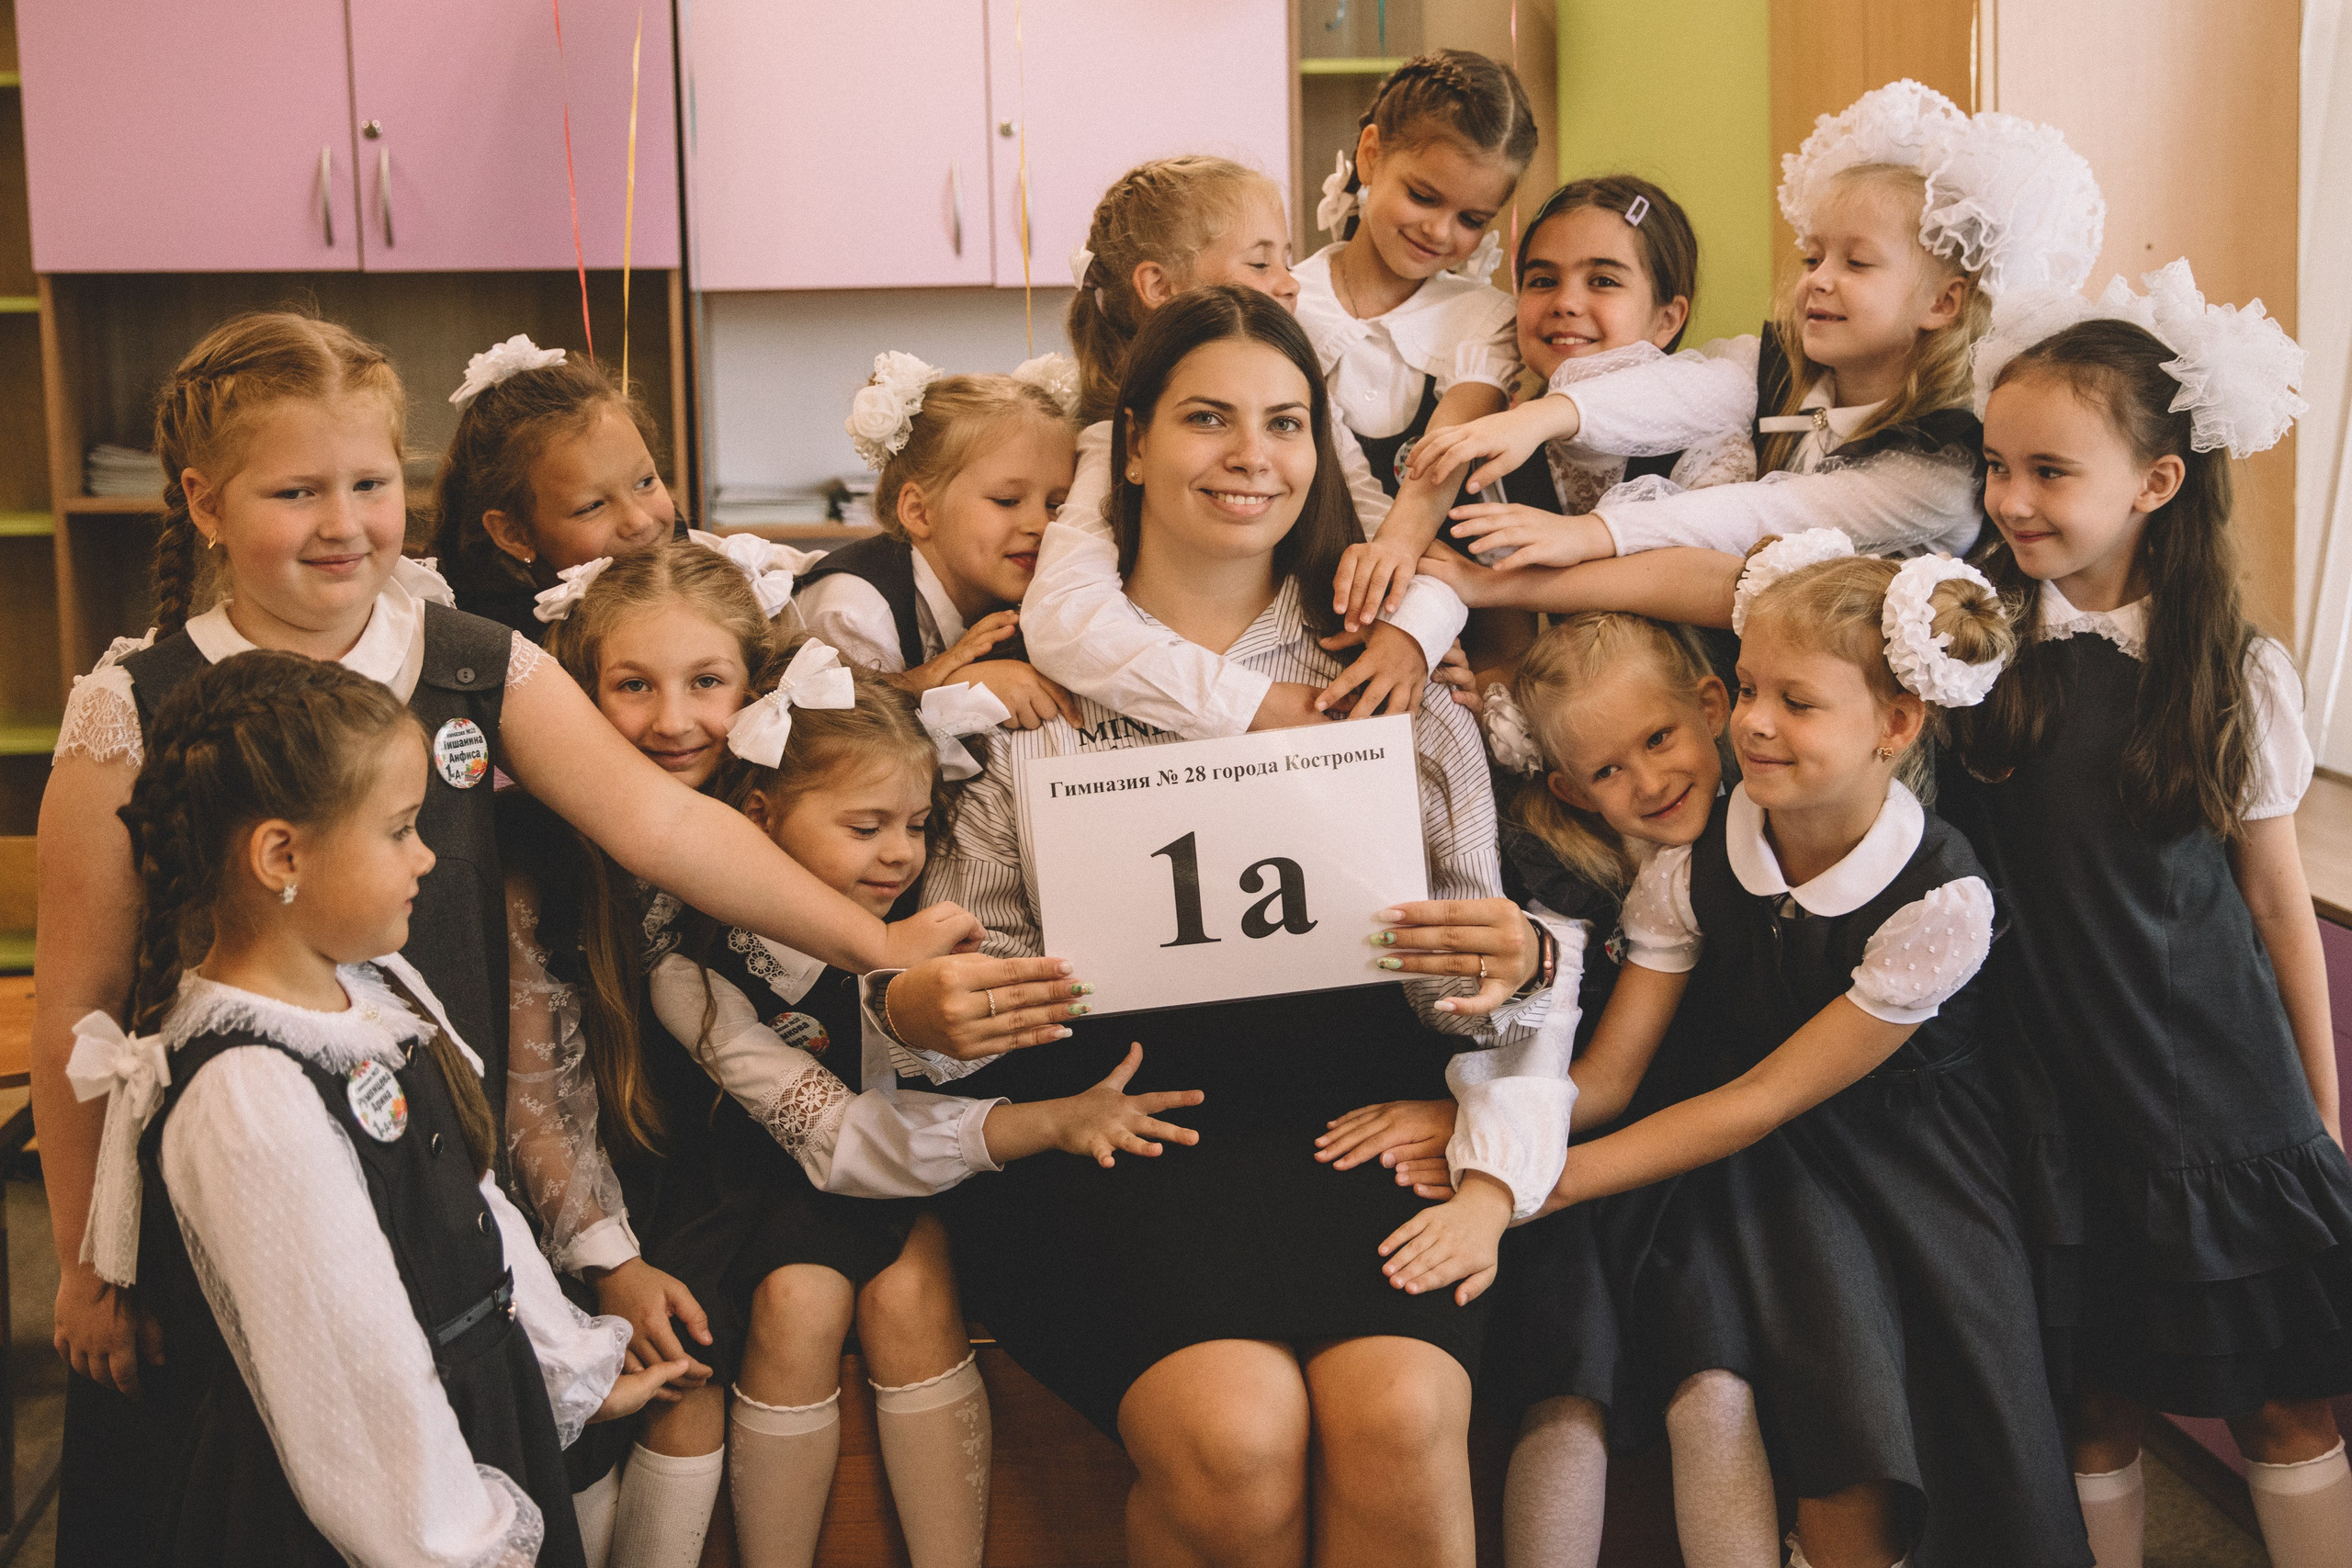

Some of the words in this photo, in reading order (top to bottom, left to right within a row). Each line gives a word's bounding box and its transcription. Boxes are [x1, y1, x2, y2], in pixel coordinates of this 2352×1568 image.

[449, 750, 481, 763] Анфиса
[1049, 774, 1151, 798] Гимназия
[1156, 769, 1179, 787] №
[1183, 764, 1207, 784] 28
[1212, 759, 1279, 782] города
[1283, 745, 1386, 771] Костромы
[1150, 830, 1319, 948] 1а
[370, 1089, 393, 1112] Арина
